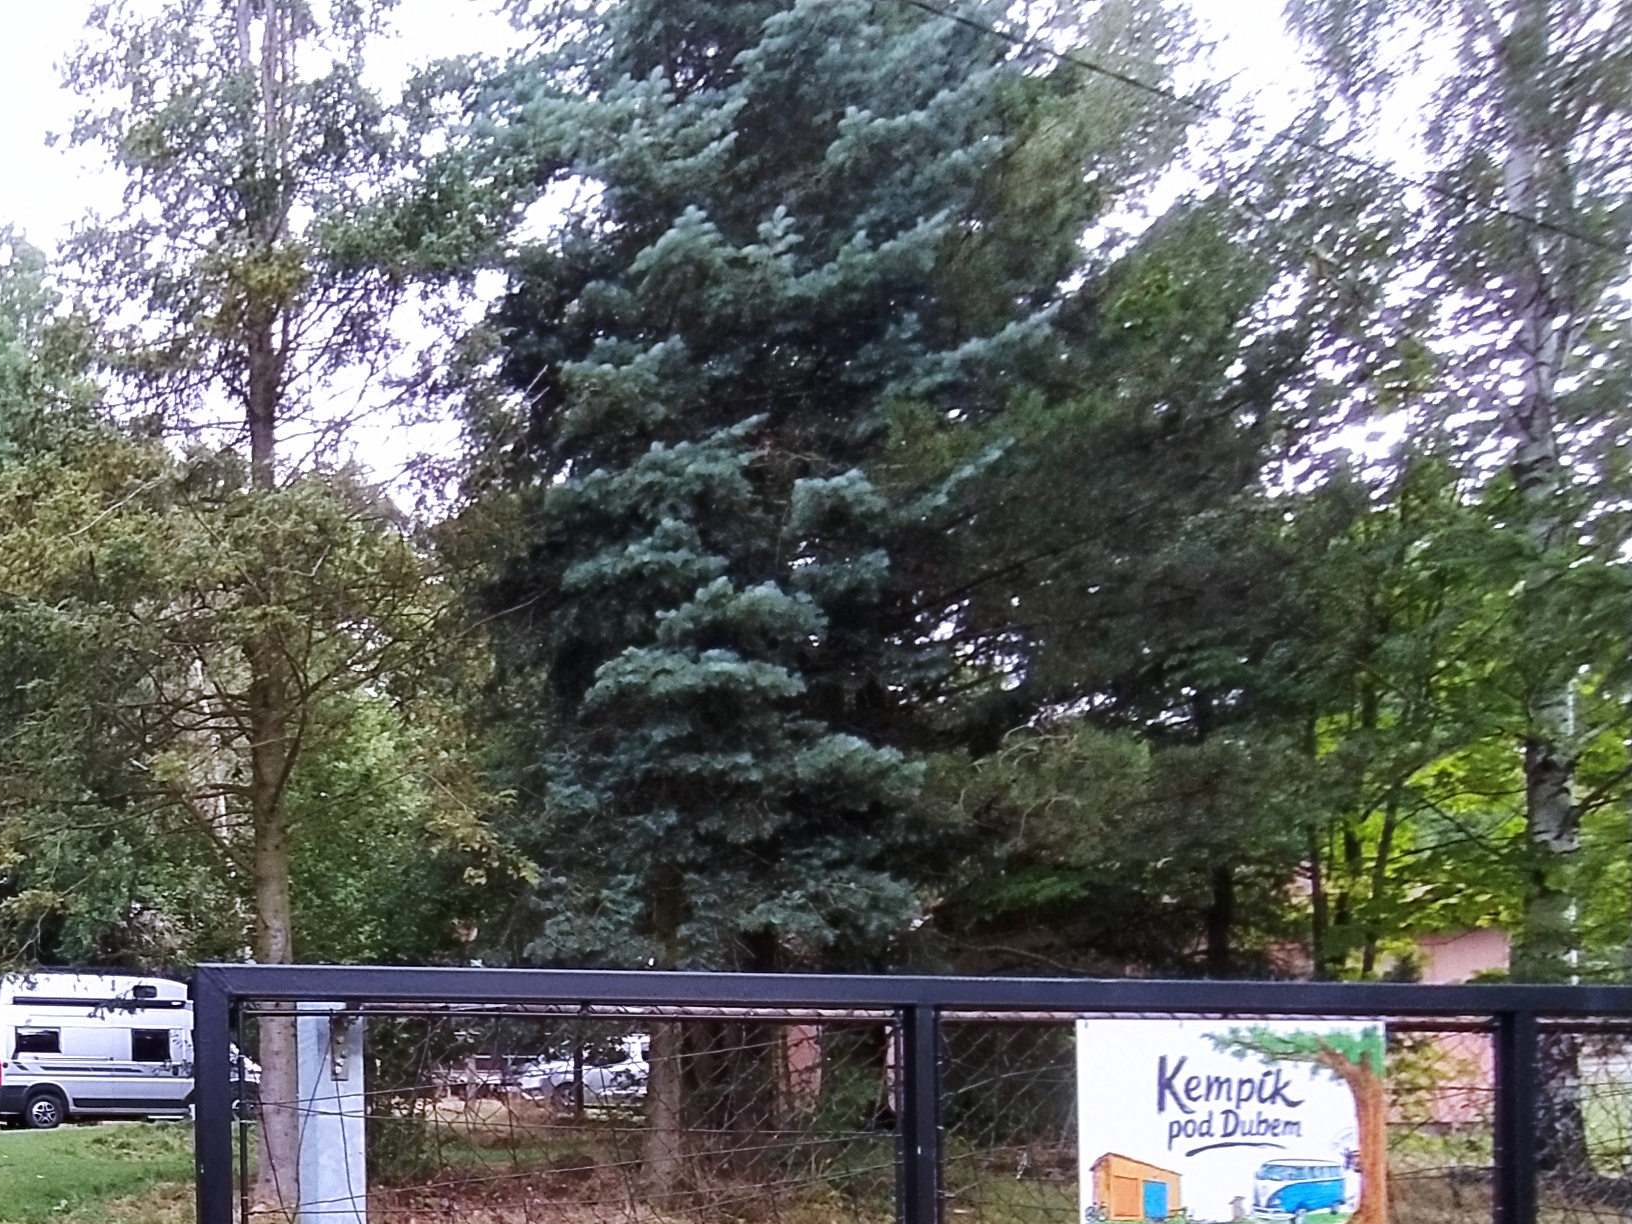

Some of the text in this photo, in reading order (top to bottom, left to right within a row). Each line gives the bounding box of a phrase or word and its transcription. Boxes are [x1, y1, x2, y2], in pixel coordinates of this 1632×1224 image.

[1157, 1054, 1306, 1114] Kempík
[1167, 1109, 1303, 1151] pod Dubem
